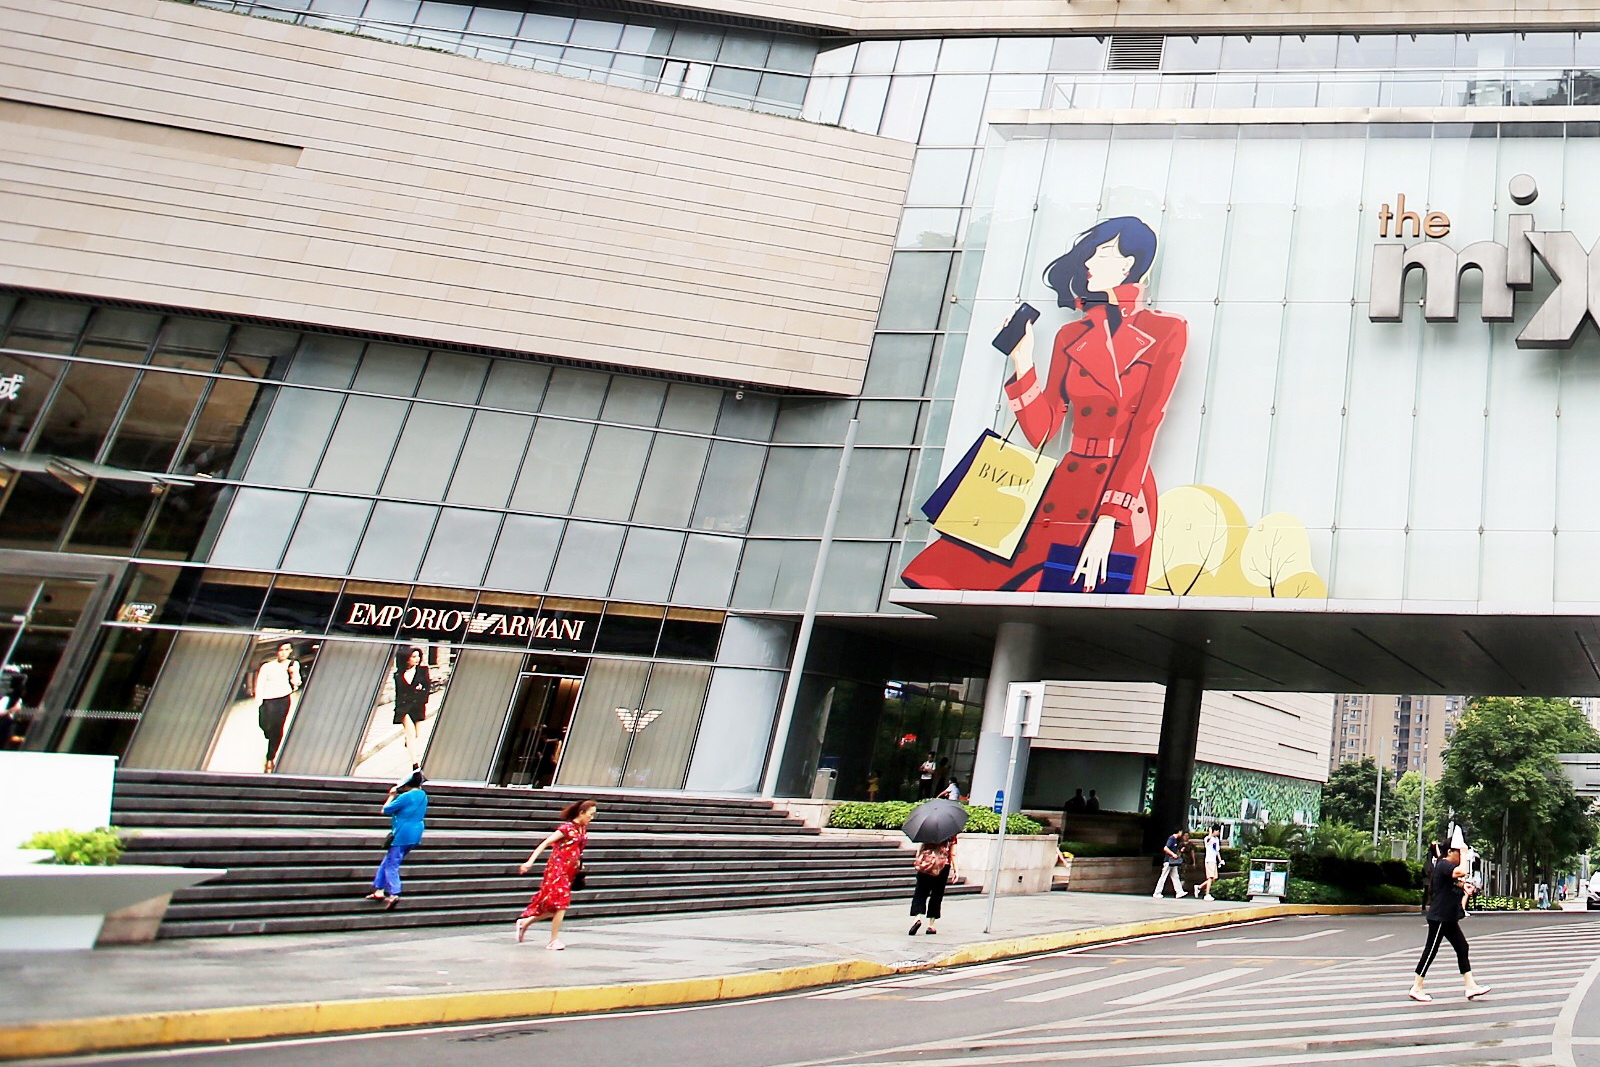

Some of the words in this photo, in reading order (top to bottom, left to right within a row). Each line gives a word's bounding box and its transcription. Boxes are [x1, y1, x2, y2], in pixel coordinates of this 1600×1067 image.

[1379, 193, 1451, 238] the
[347, 602, 463, 632] EMPORIO
[490, 614, 586, 642] ARMANI
